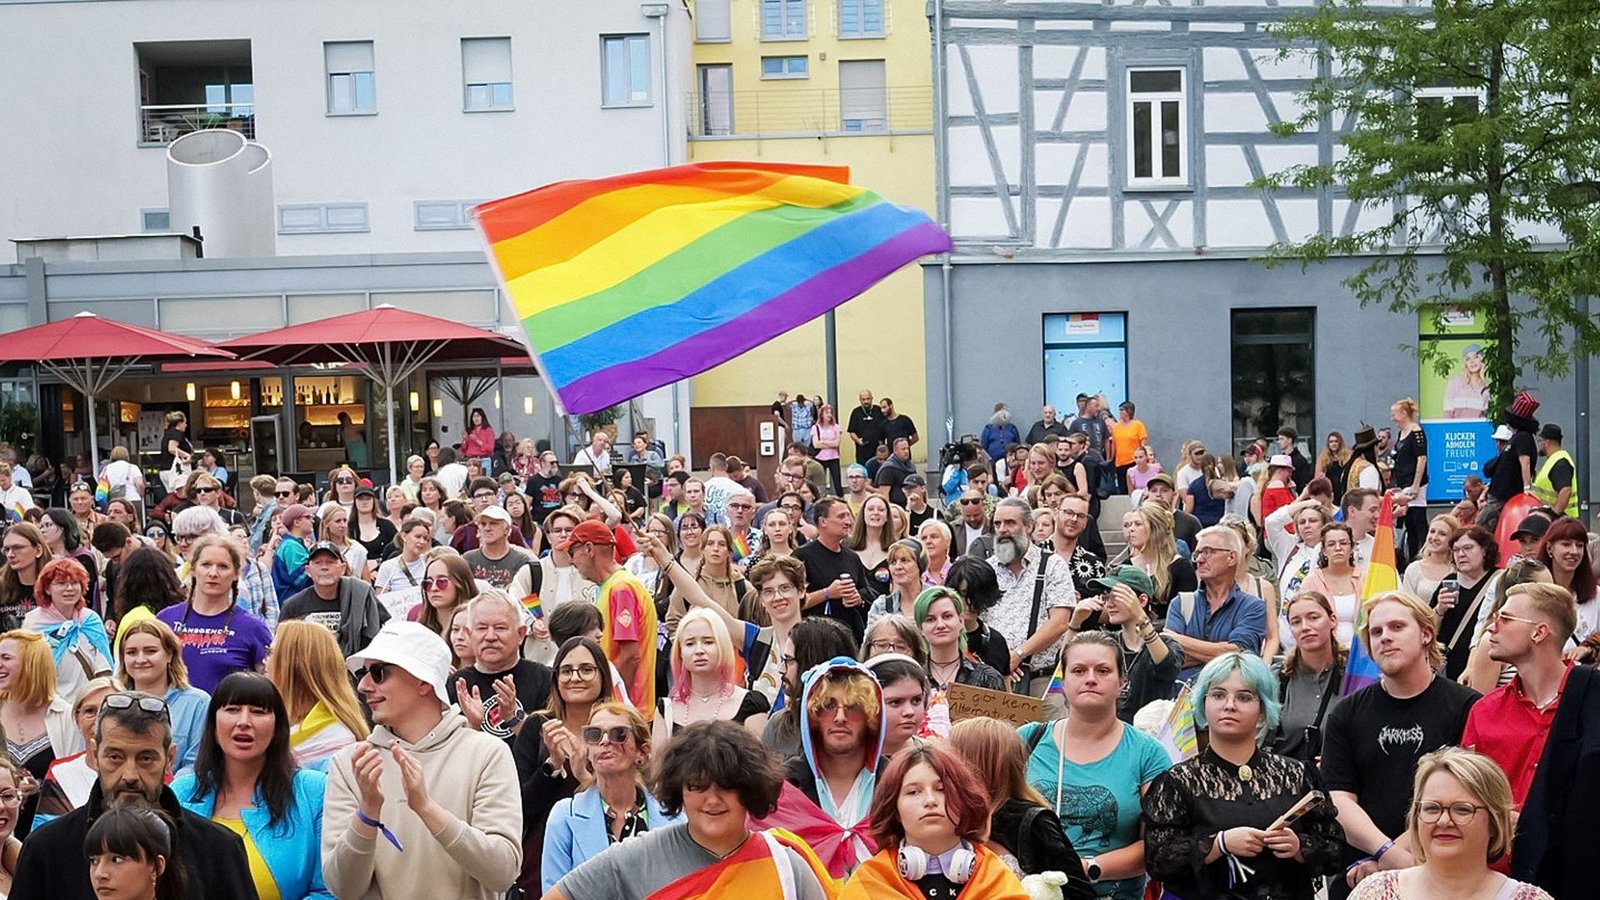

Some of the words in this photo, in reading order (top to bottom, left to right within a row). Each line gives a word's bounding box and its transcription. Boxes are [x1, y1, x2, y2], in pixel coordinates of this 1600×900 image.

[1445, 432, 1475, 440] KLICKEN
[1445, 441, 1475, 449] ABHOLEN
[1445, 449, 1475, 458] FREUEN
[950, 685, 965, 700] Es
[1002, 695, 1037, 712] keine
